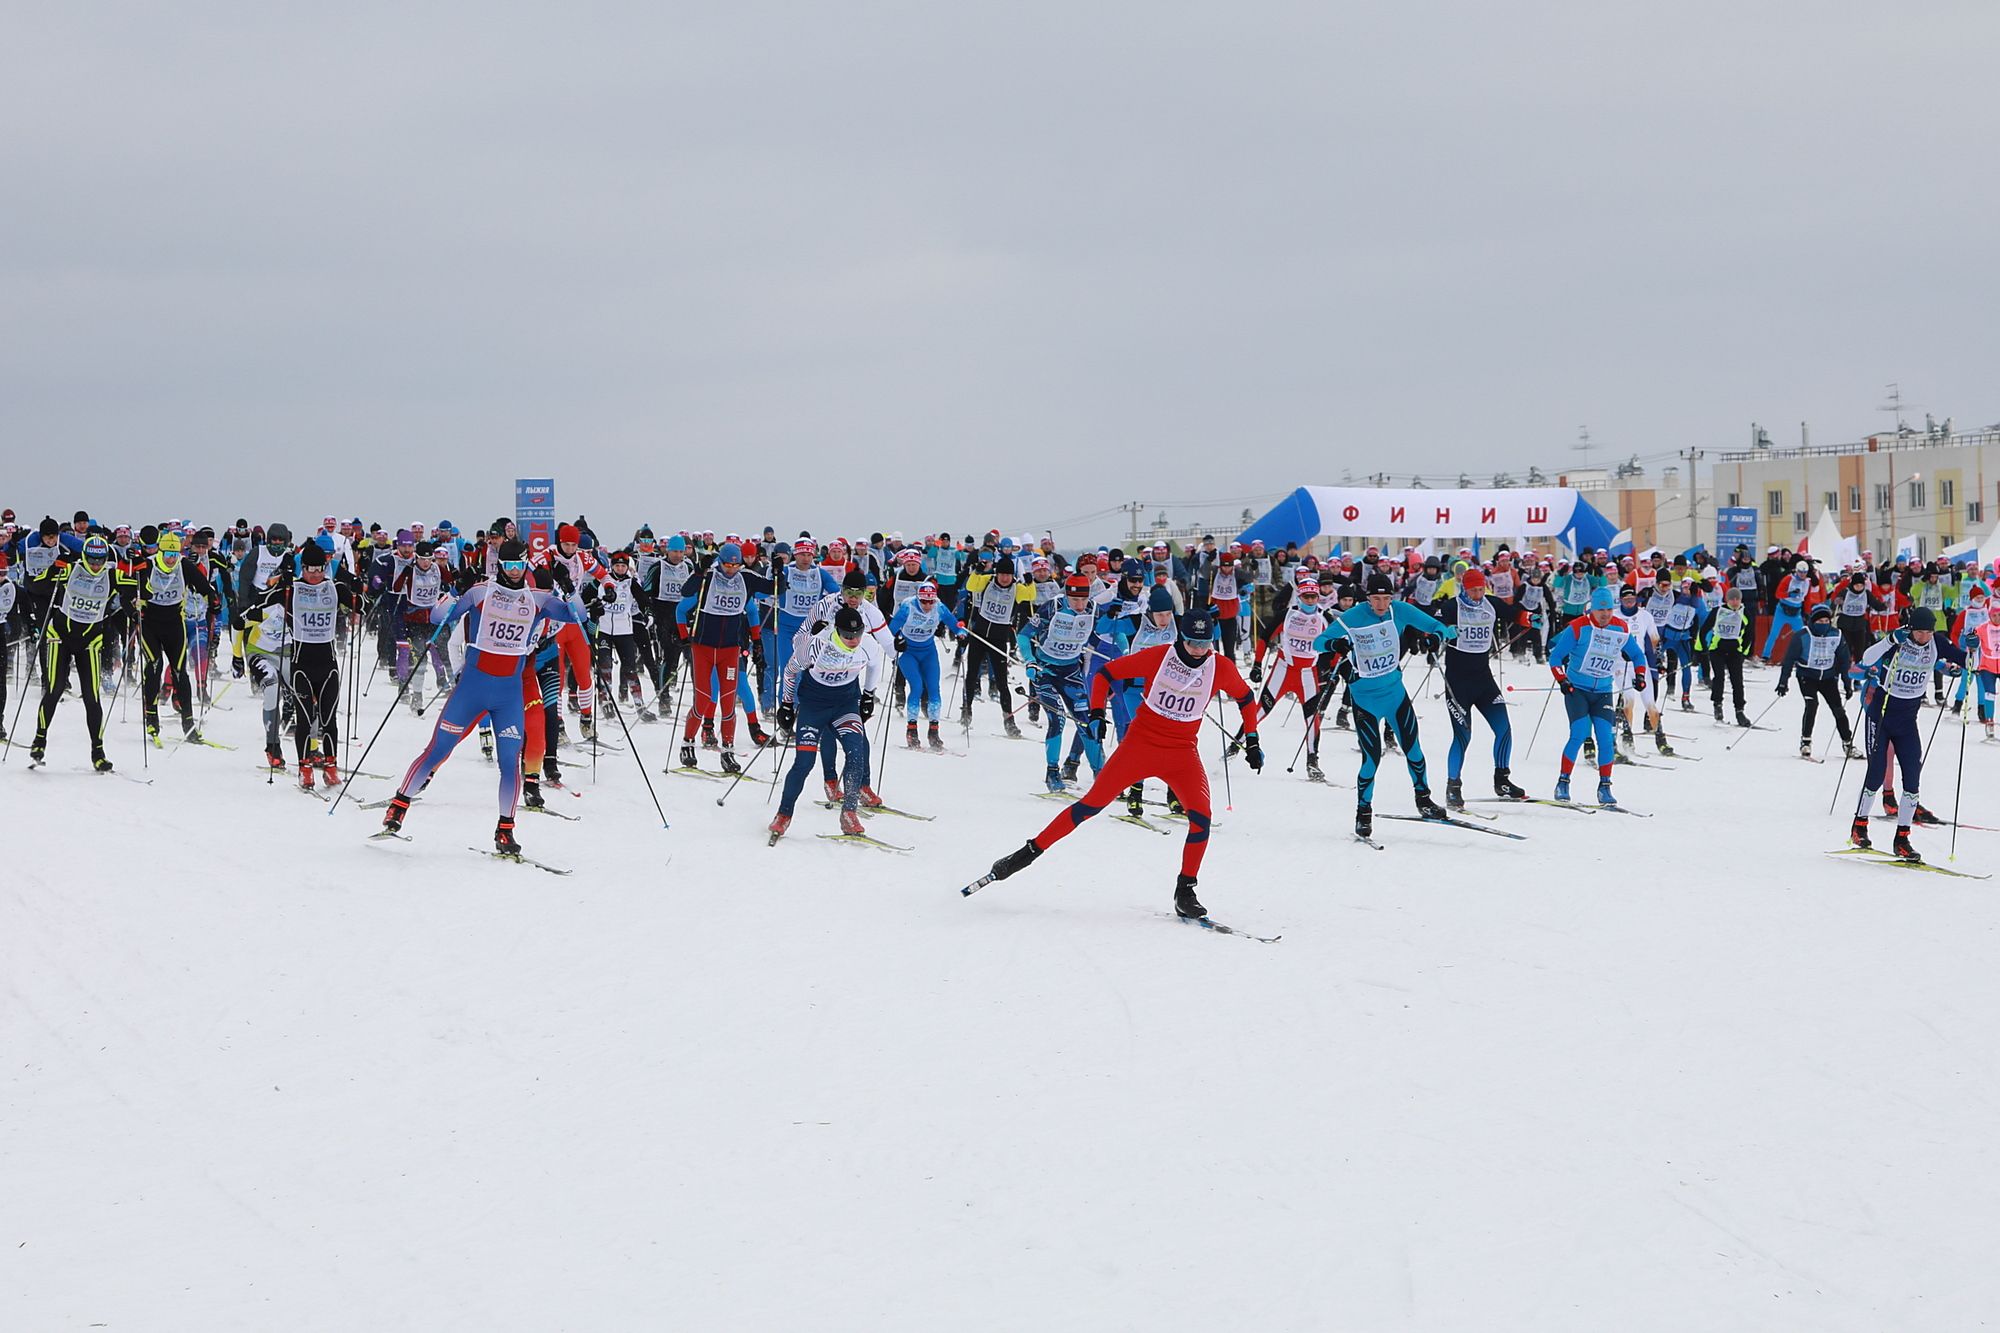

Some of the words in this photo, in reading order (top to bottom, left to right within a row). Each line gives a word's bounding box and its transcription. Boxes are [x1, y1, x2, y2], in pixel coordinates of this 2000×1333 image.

[526, 486, 550, 494] ЛЫЖНЯ
[1343, 505, 1548, 524] ФИНИШ
[666, 582, 681, 593] 183
[71, 595, 101, 611] 1994
[714, 594, 741, 609] 1659
[793, 595, 818, 607] 1935
[986, 601, 1007, 615] 1830
[301, 612, 332, 627] 1455
[489, 621, 525, 642] 1852
[1463, 626, 1490, 640] 1586
[1289, 638, 1312, 652] 1781
[1166, 662, 1191, 677] РОССИИ
[1364, 654, 1396, 672] 1422
[1590, 656, 1615, 672] 1702
[1895, 669, 1927, 686] 1686
[1158, 690, 1196, 713] 1010
[1446, 698, 1464, 726] LUKOIL
